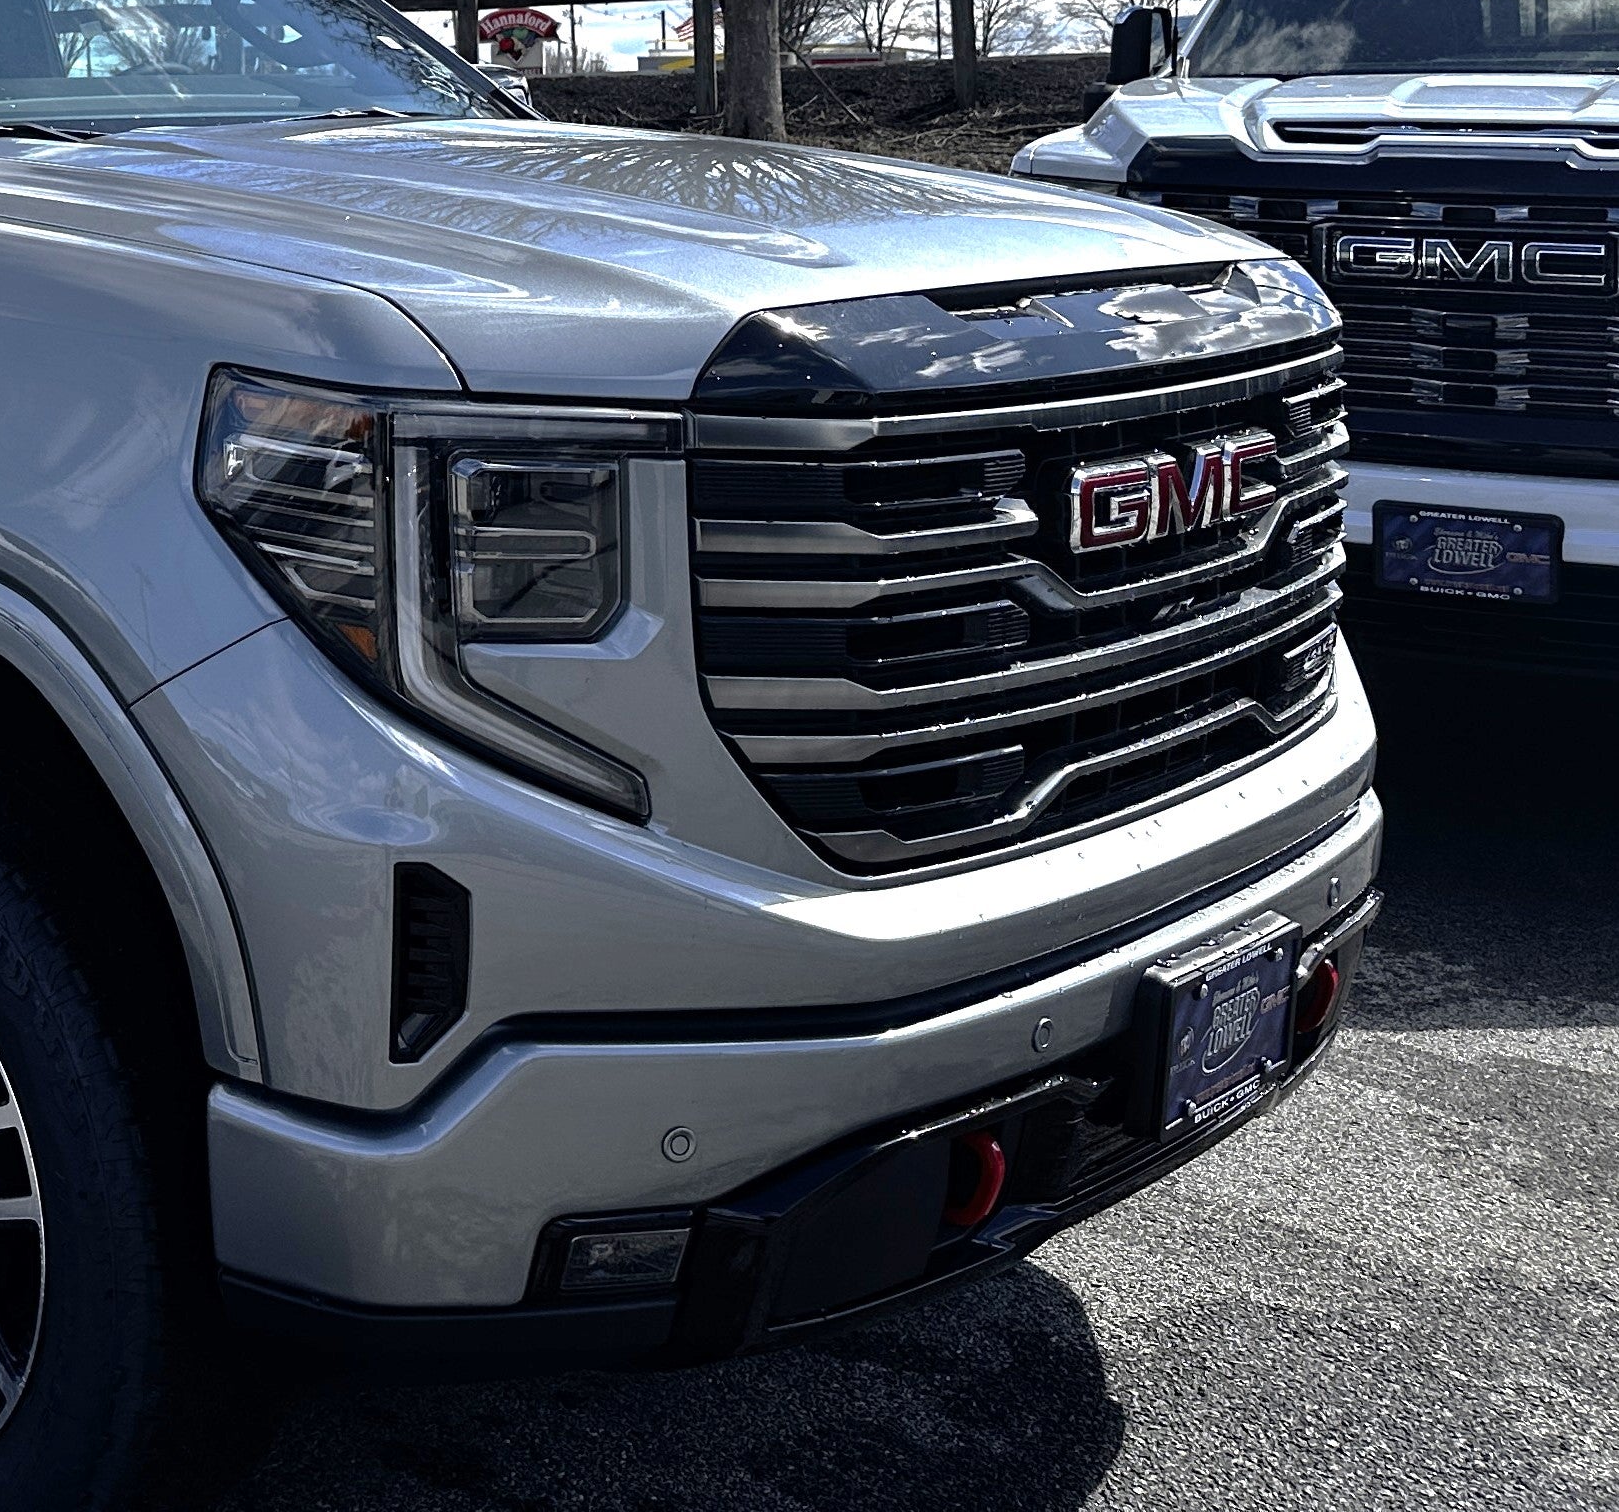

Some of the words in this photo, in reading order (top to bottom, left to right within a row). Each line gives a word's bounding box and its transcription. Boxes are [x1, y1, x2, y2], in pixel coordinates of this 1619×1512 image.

[480, 12, 552, 35] Hannaford
[1336, 235, 1606, 286] GMC
[1069, 430, 1277, 554] GMC
[1419, 510, 1466, 521] GREATER
[1468, 514, 1511, 525] LOWELL
[1436, 536, 1499, 555] GREATER
[1433, 548, 1495, 569] LOWELL
[1420, 585, 1465, 596] BUICK
[1205, 959, 1241, 982] GREATER
[1241, 942, 1273, 964] LOWELL
[1194, 1097, 1229, 1124] BUICK
